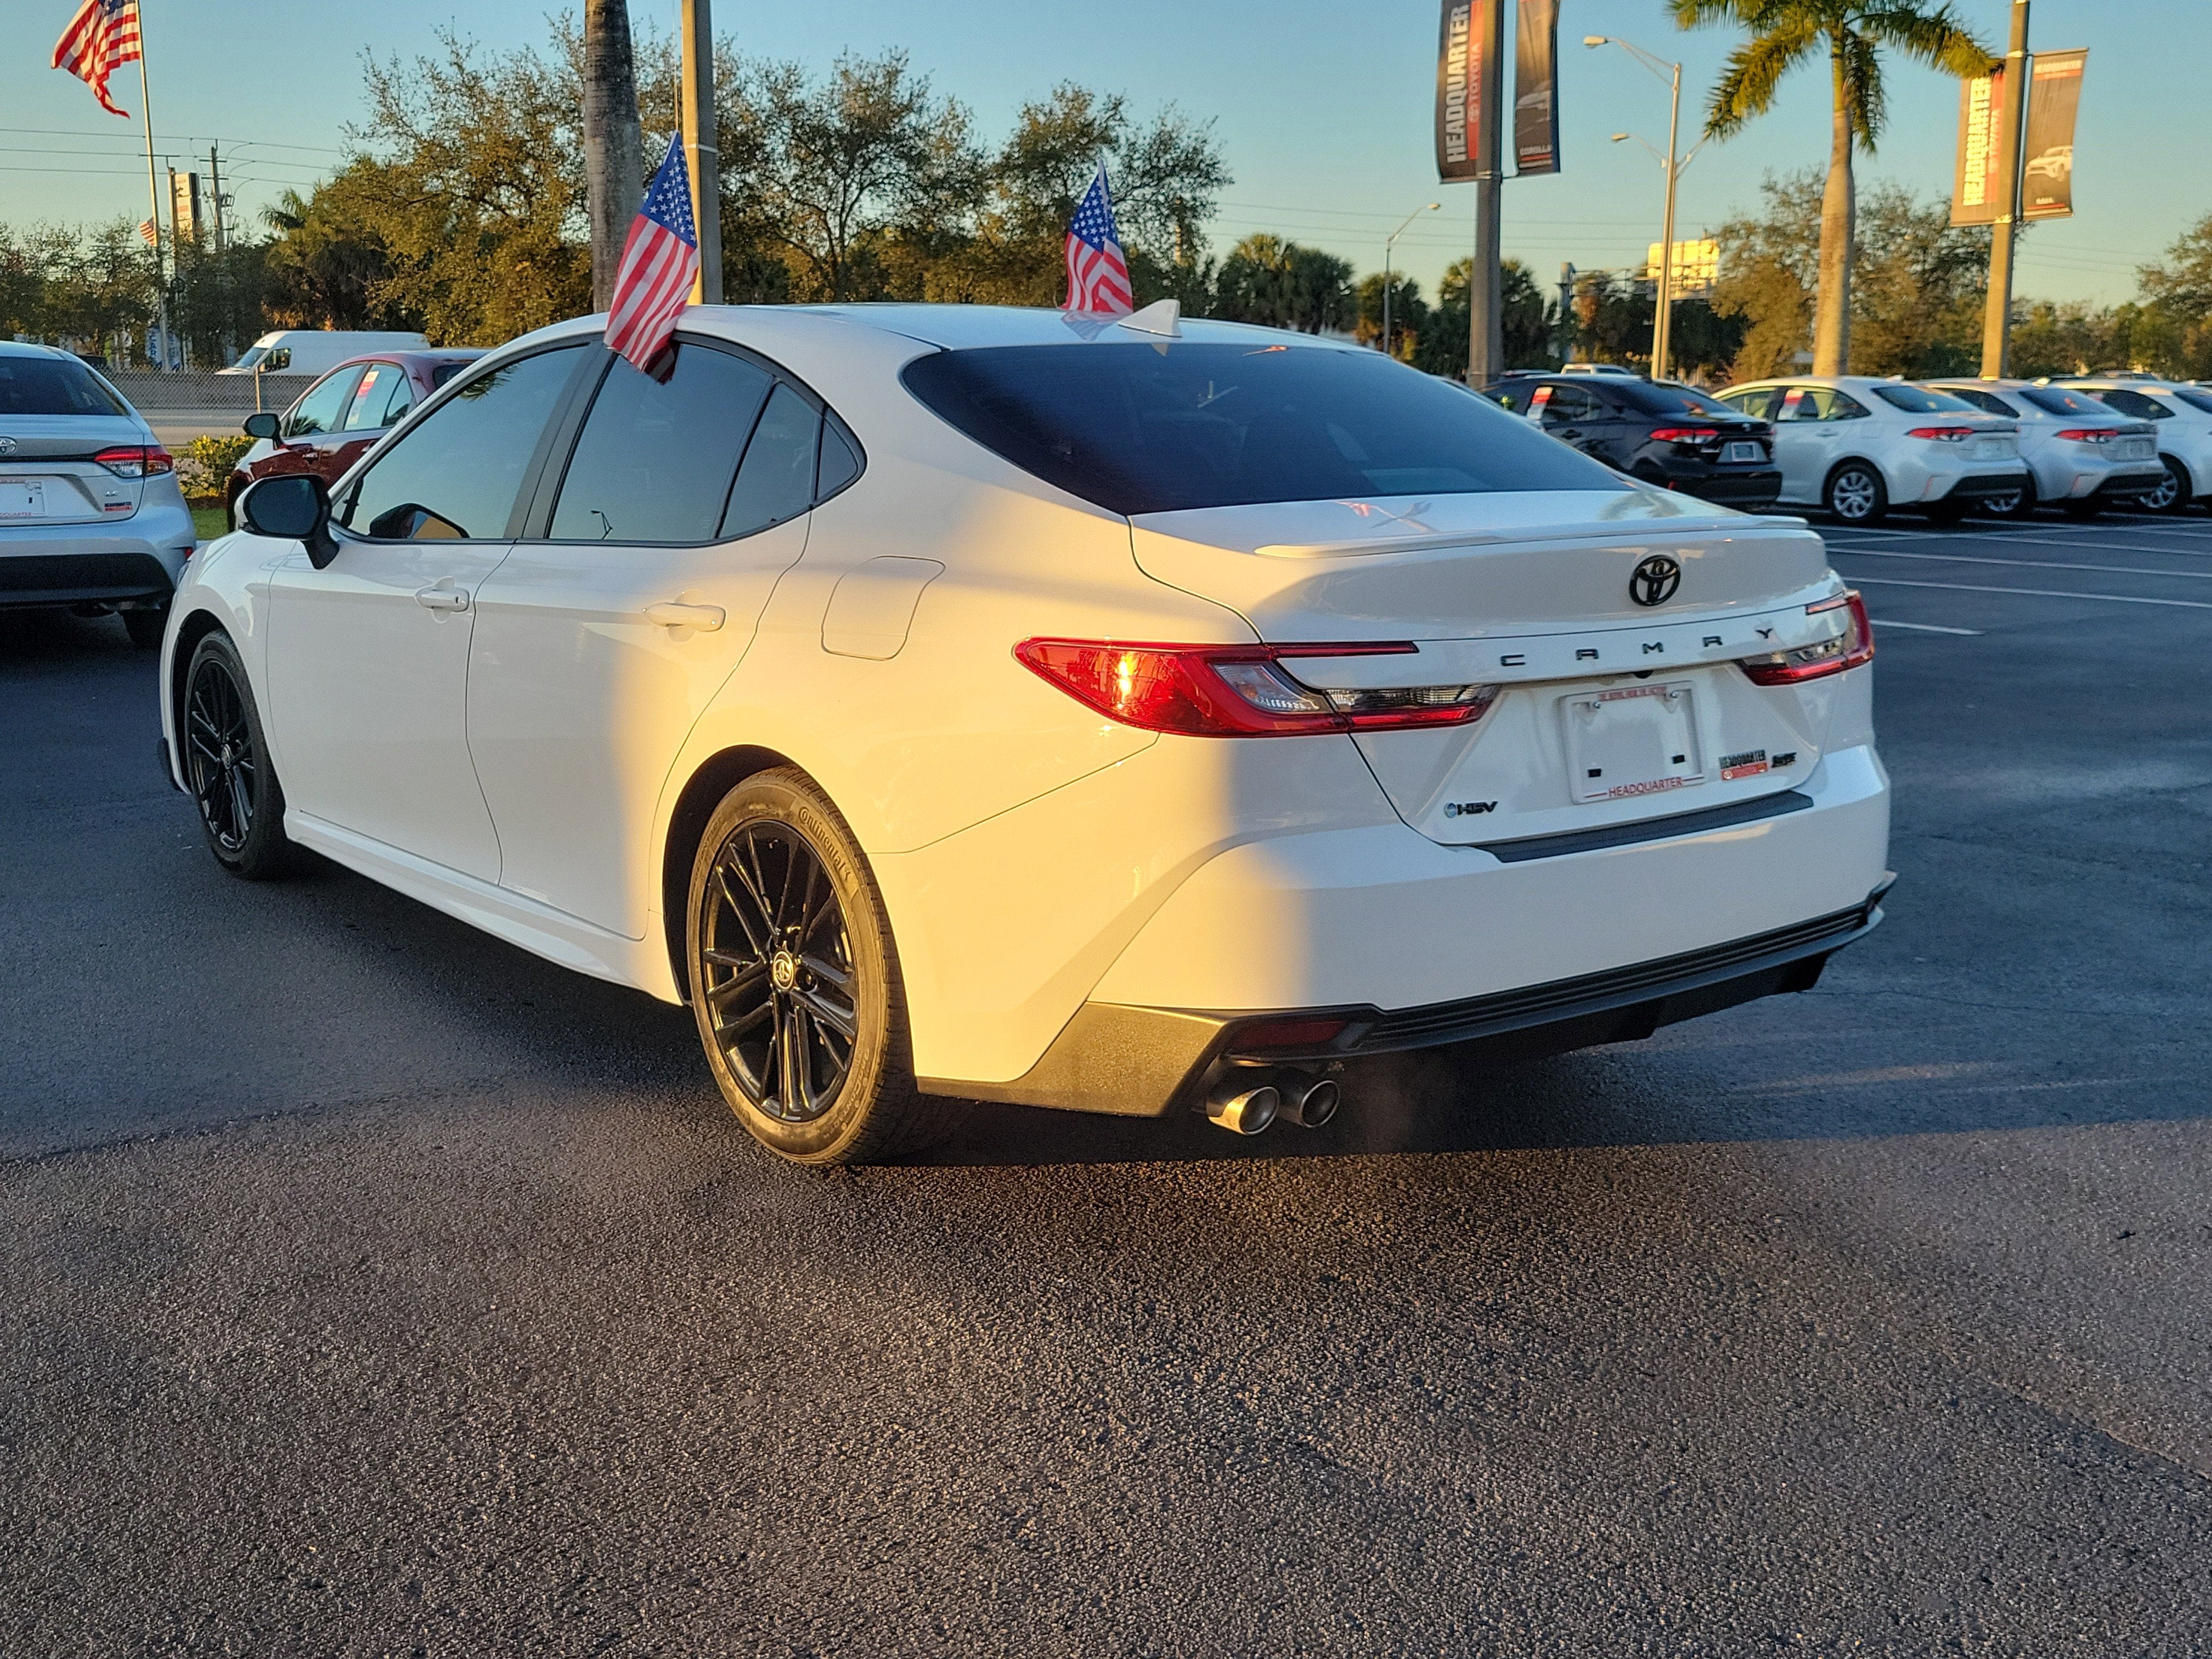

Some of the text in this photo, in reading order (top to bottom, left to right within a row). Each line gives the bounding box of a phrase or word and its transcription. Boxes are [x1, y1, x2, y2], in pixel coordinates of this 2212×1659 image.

[1445, 4, 1470, 163] HEADQUARTER
[1469, 43, 1481, 102] TOYOTA
[1962, 76, 1991, 206] HEADQUARTER
[1500, 628, 1774, 667] CAMRY
[1609, 776, 1683, 797] HEADQUARTER
[798, 806, 847, 872] Continental
